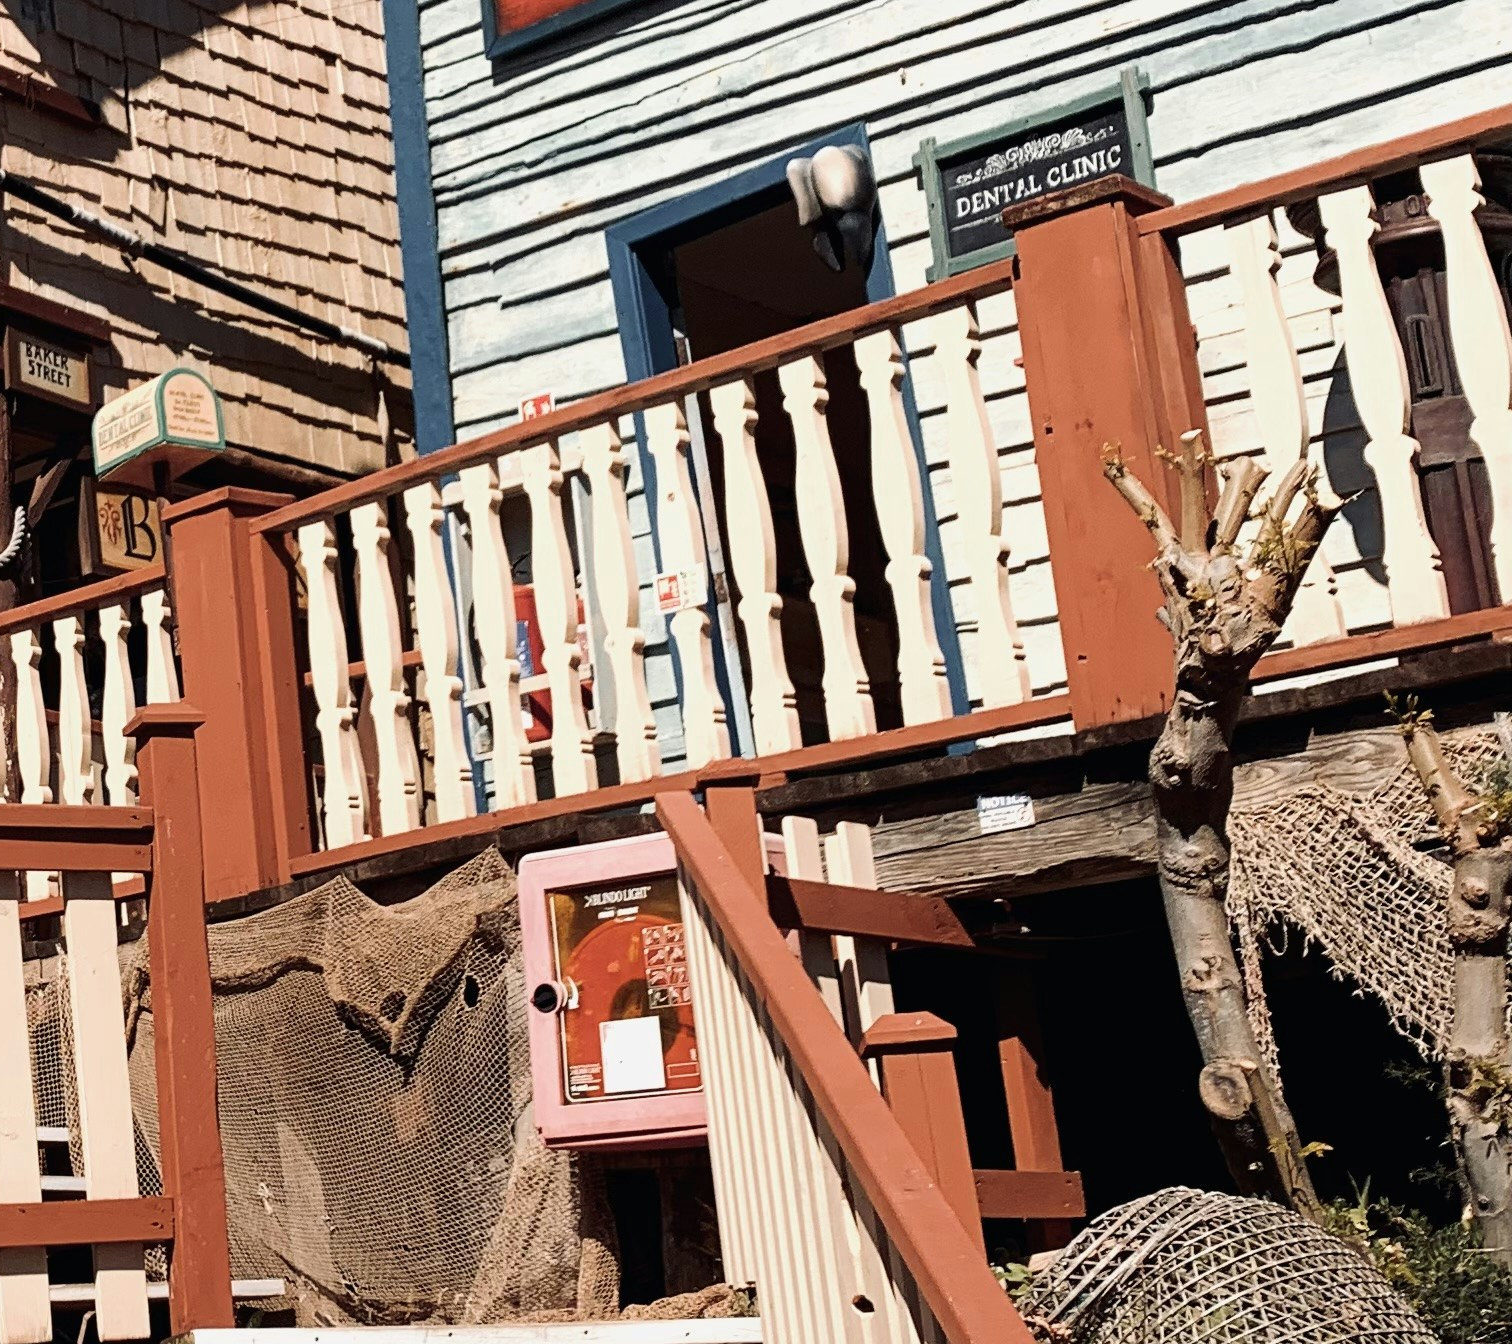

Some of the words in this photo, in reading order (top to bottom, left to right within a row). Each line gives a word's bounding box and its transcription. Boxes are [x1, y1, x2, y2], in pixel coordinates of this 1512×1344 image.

[955, 176, 1041, 217] DENTAL
[1046, 145, 1122, 188] CLINIC
[26, 342, 69, 371] BAKER
[29, 359, 71, 387] STREET
